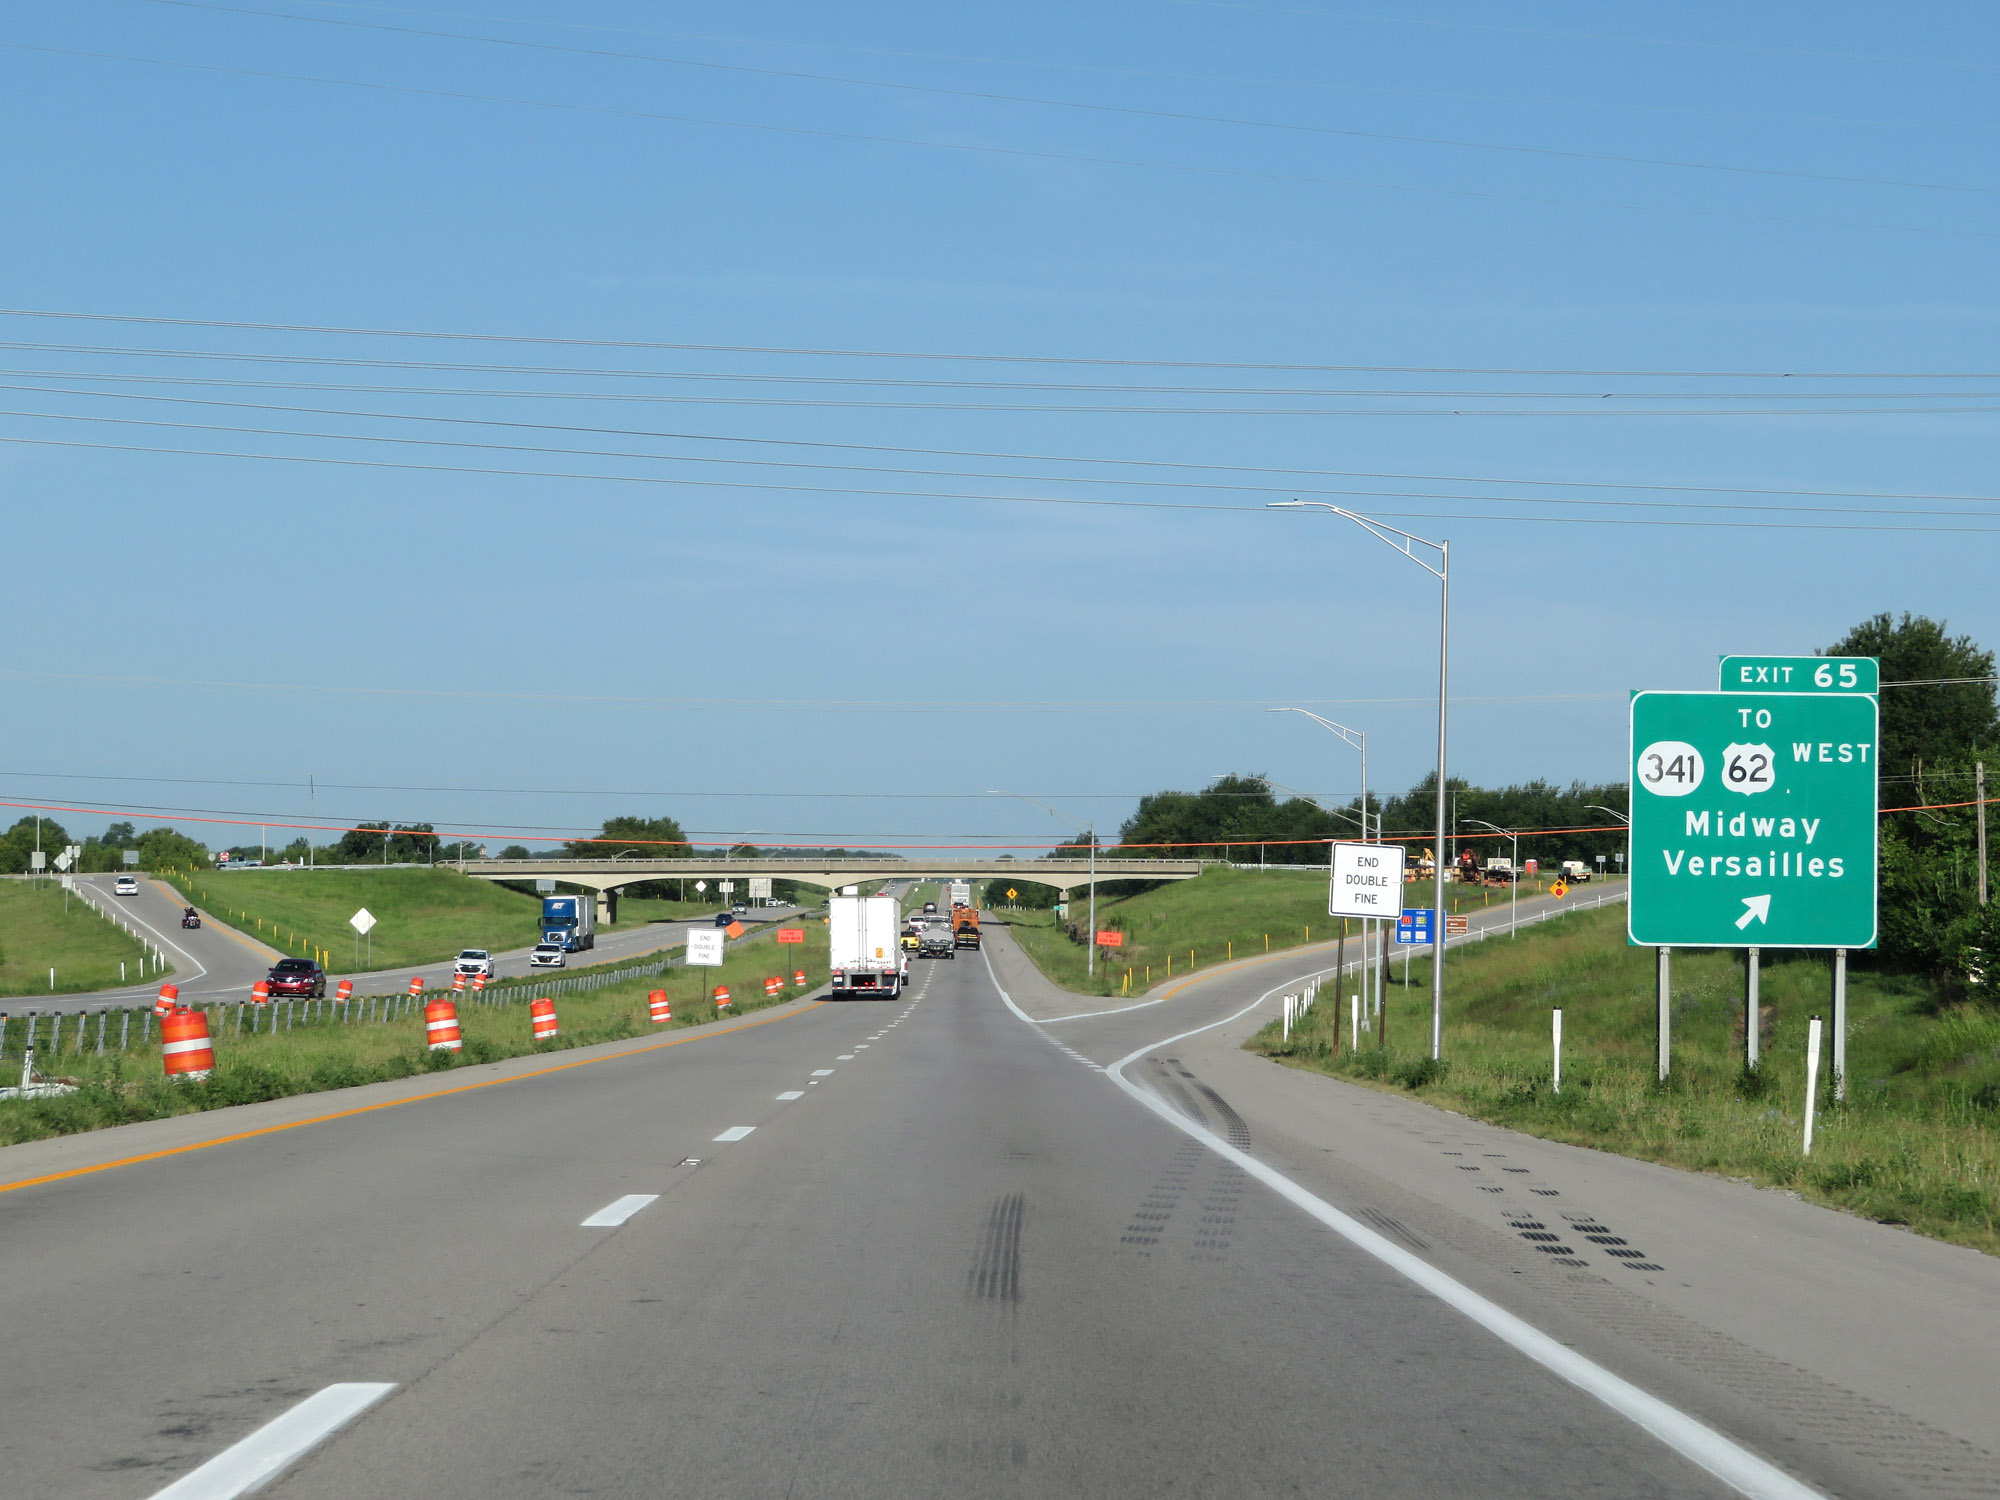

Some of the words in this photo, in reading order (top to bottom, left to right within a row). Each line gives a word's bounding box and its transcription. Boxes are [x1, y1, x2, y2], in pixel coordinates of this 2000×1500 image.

[1740, 666, 1794, 683] EXIT
[1814, 663, 1858, 688] 65
[1738, 708, 1772, 728] TO
[1645, 753, 1695, 784] 341
[1728, 753, 1768, 783] 62
[1792, 742, 1871, 763] WEST
[1685, 810, 1820, 844] Midway
[1357, 856, 1379, 868] END
[1662, 849, 1845, 877] Versailles
[1346, 873, 1388, 887] DOUBLE
[1354, 892, 1378, 905] FINE
